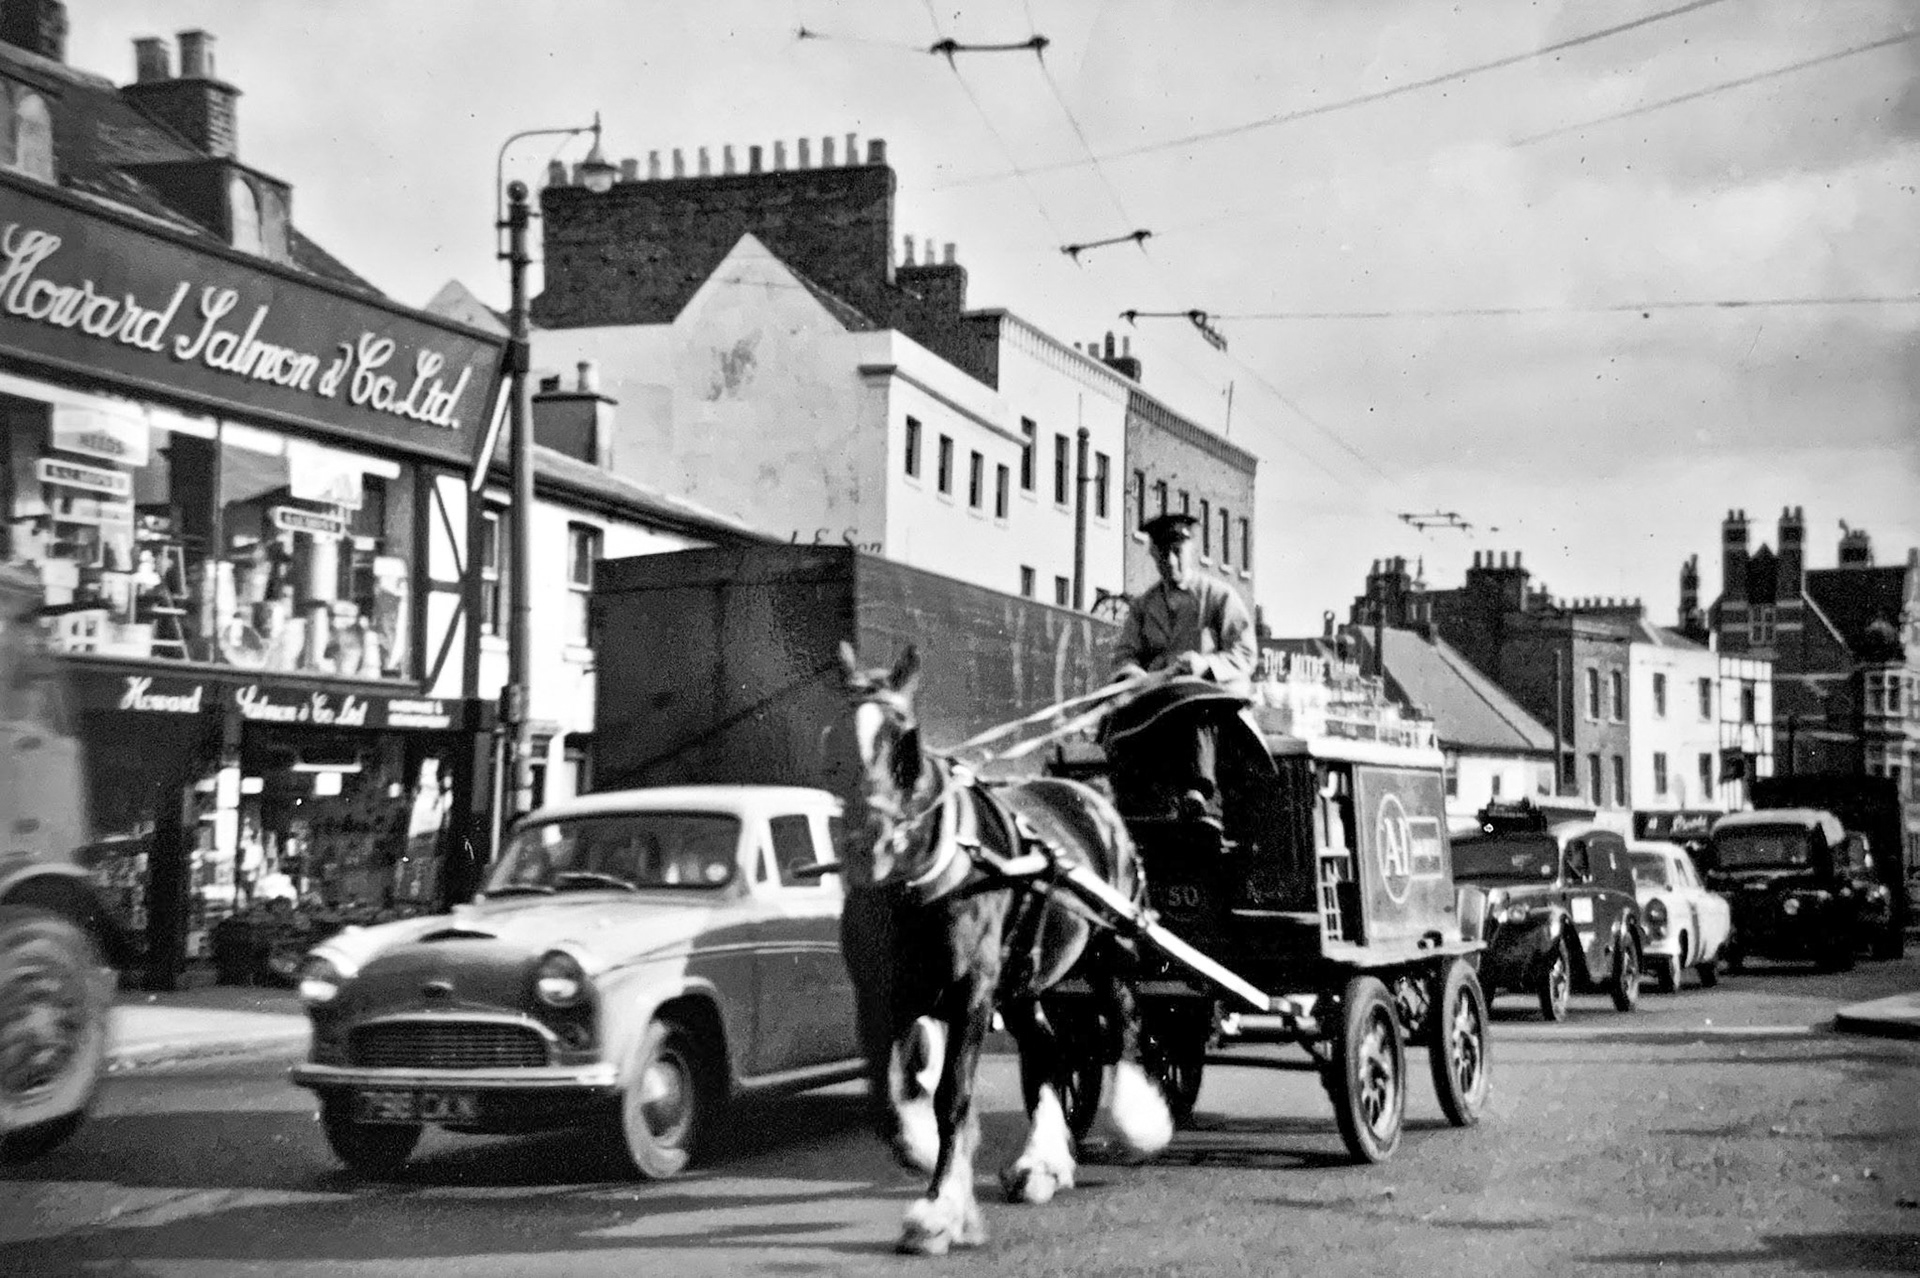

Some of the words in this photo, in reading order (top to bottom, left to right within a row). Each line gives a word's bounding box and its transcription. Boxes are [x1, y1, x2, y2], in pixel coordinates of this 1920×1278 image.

[0, 223, 191, 351] Howard
[174, 283, 320, 391] Salmon
[404, 349, 473, 429] Ltd.
